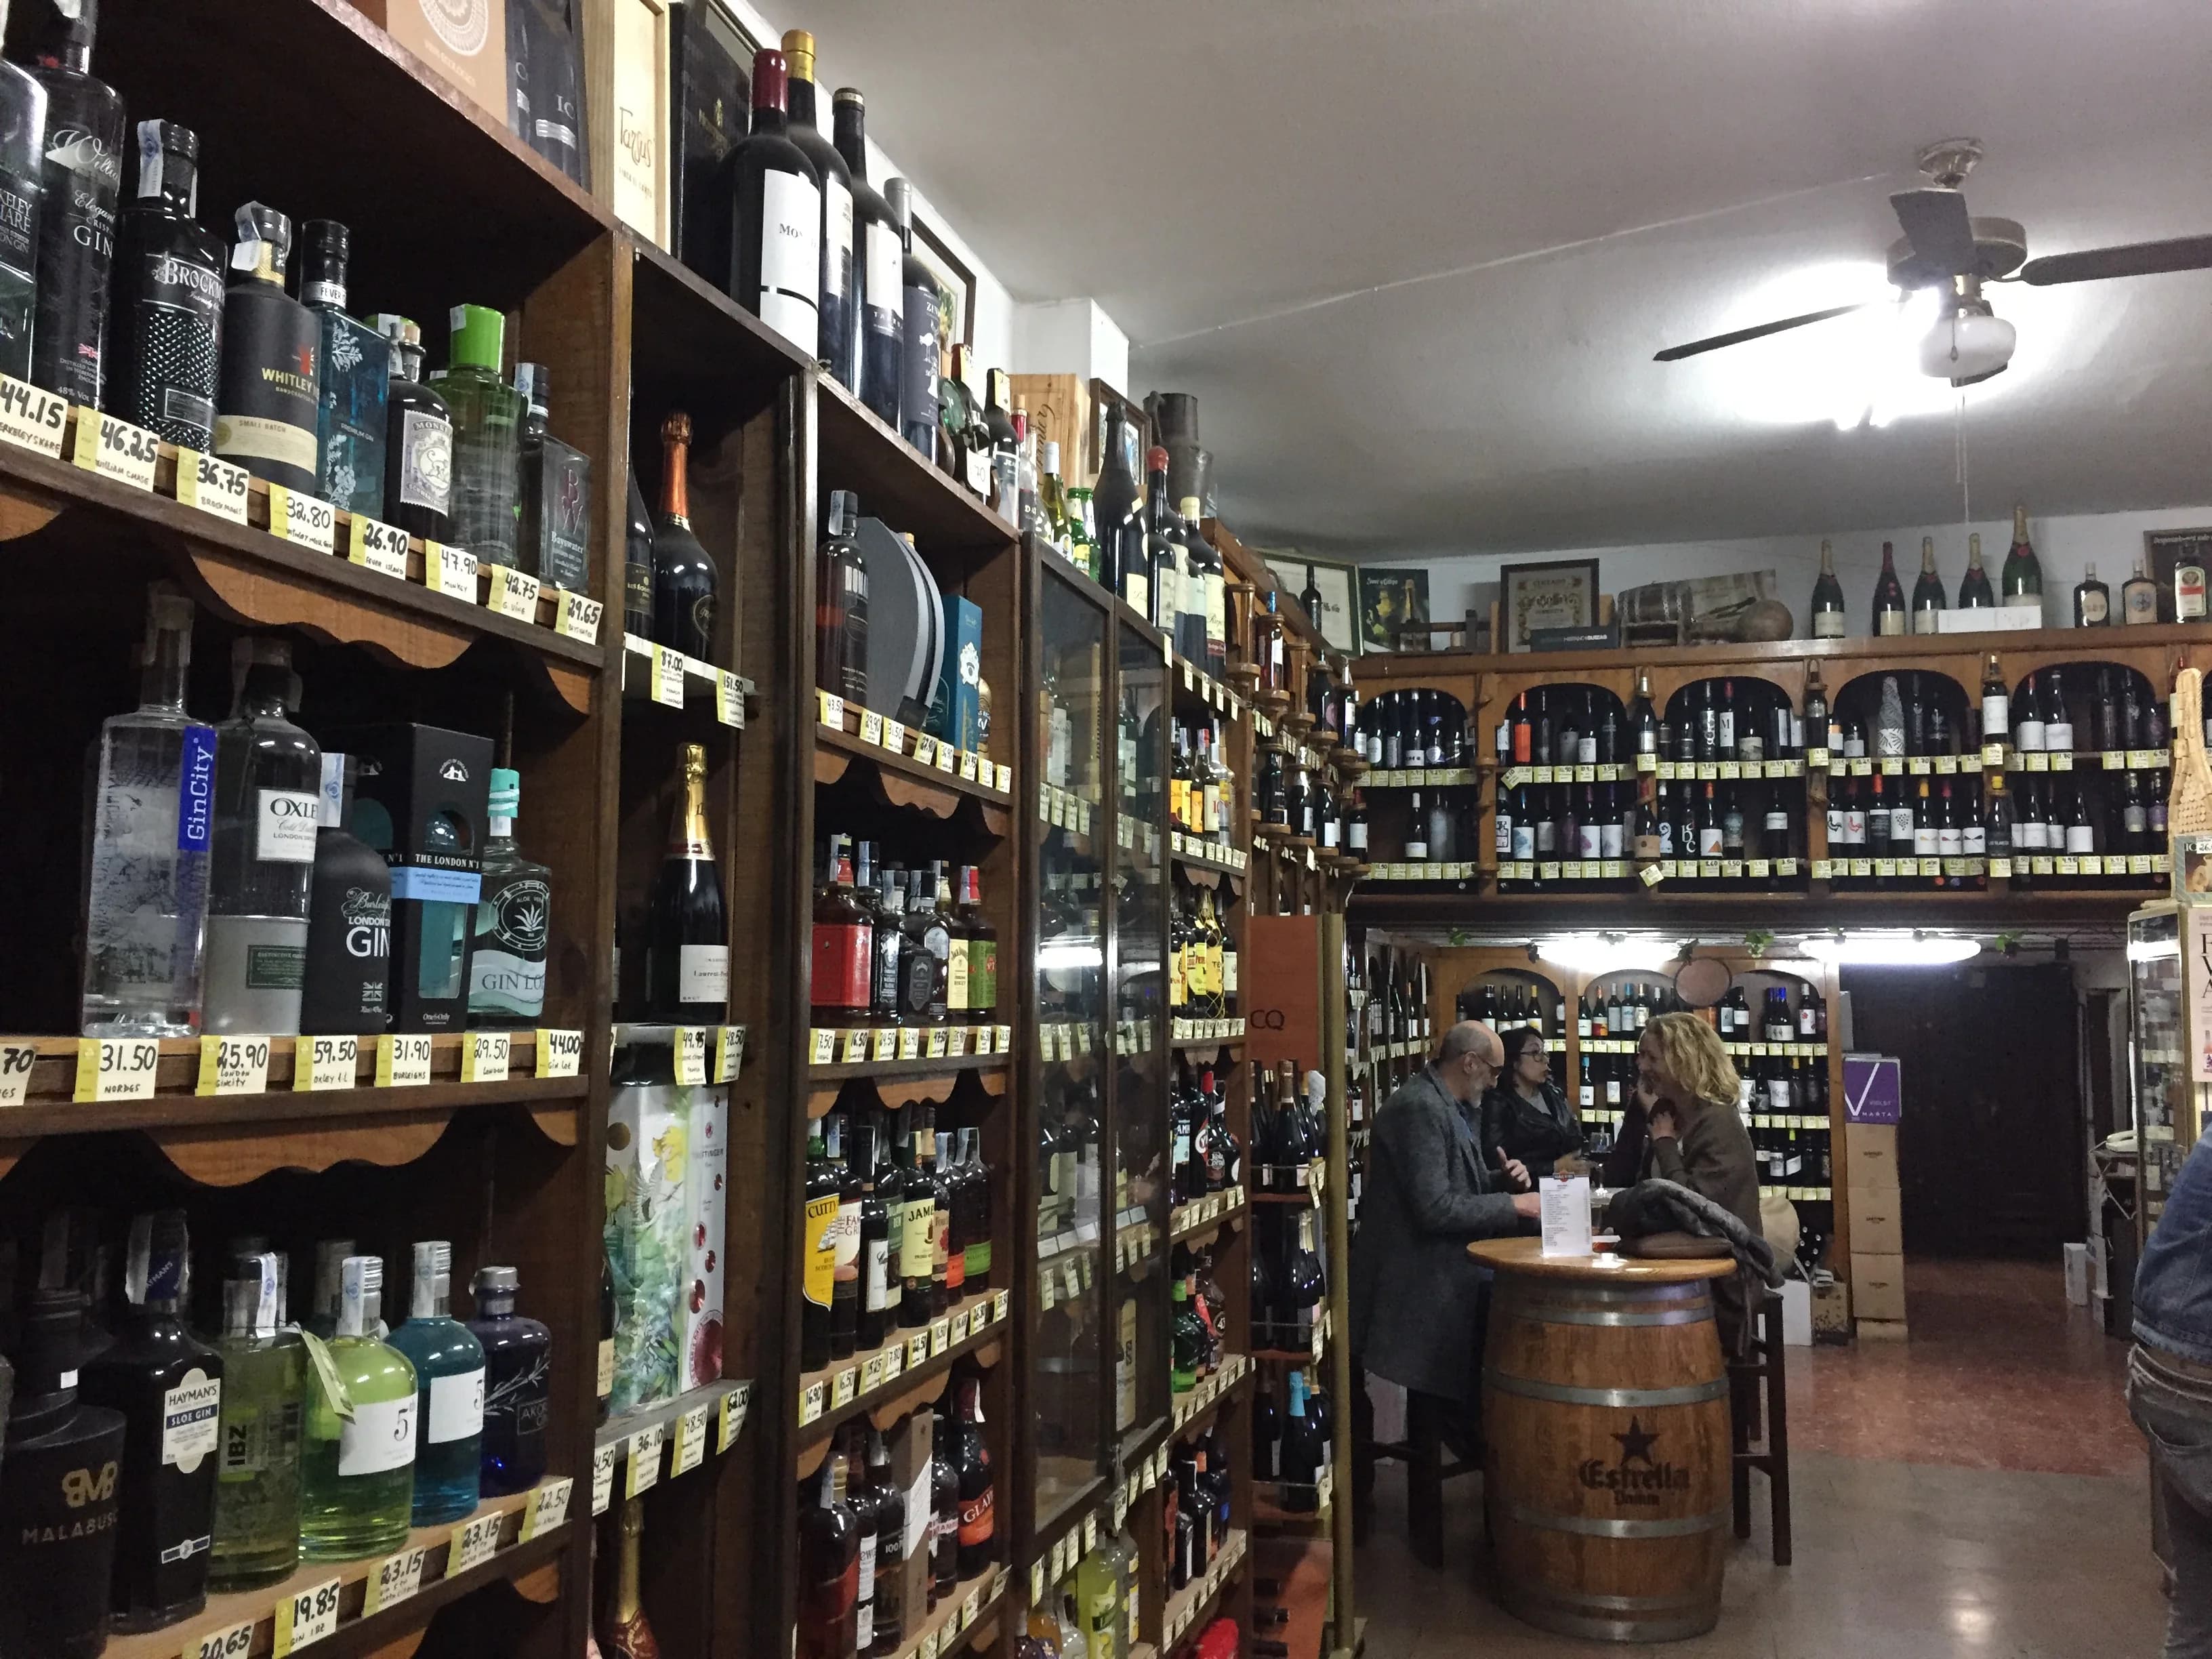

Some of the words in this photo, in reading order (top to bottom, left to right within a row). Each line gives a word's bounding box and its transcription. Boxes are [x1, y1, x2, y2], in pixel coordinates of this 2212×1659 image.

[74, 225, 113, 259] GIN
[262, 367, 312, 393] WHITLEY
[0, 380, 64, 429] 44.15
[0, 422, 33, 444] ERKELEY
[239, 419, 263, 429] SMALL
[264, 422, 287, 433] BATCH
[100, 419, 159, 464] 46.25
[196, 458, 248, 497] 36.75
[286, 496, 331, 529] 32.80
[363, 522, 408, 556] 26.90
[551, 531, 584, 554] Bayswater
[441, 548, 476, 576] 47.90
[505, 571, 537, 600] 42.75
[567, 597, 601, 626] 29.65
[187, 745, 214, 842] GinCity
[272, 832, 304, 840] LONDON
[415, 853, 432, 865] THE
[434, 855, 466, 868] LONDON
[348, 916, 384, 926] LONDON
[346, 926, 390, 958] GIN
[481, 972, 522, 991] GIN
[216, 1042, 269, 1070] 25.90
[313, 1039, 357, 1065] 59.50
[394, 1039, 431, 1061] 31.90
[474, 1038, 509, 1059] 29.50
[549, 1032, 581, 1055] 44.00
[100, 1044, 157, 1072] 31.50
[171, 1412, 193, 1427] SLOE
[195, 1408, 212, 1420] GIN
[1578, 1458, 1690, 1490] Estrella
[462, 1516, 501, 1549] 23.15
[380, 1553, 423, 1585] 23.15
[293, 1586, 337, 1627] 19.85
